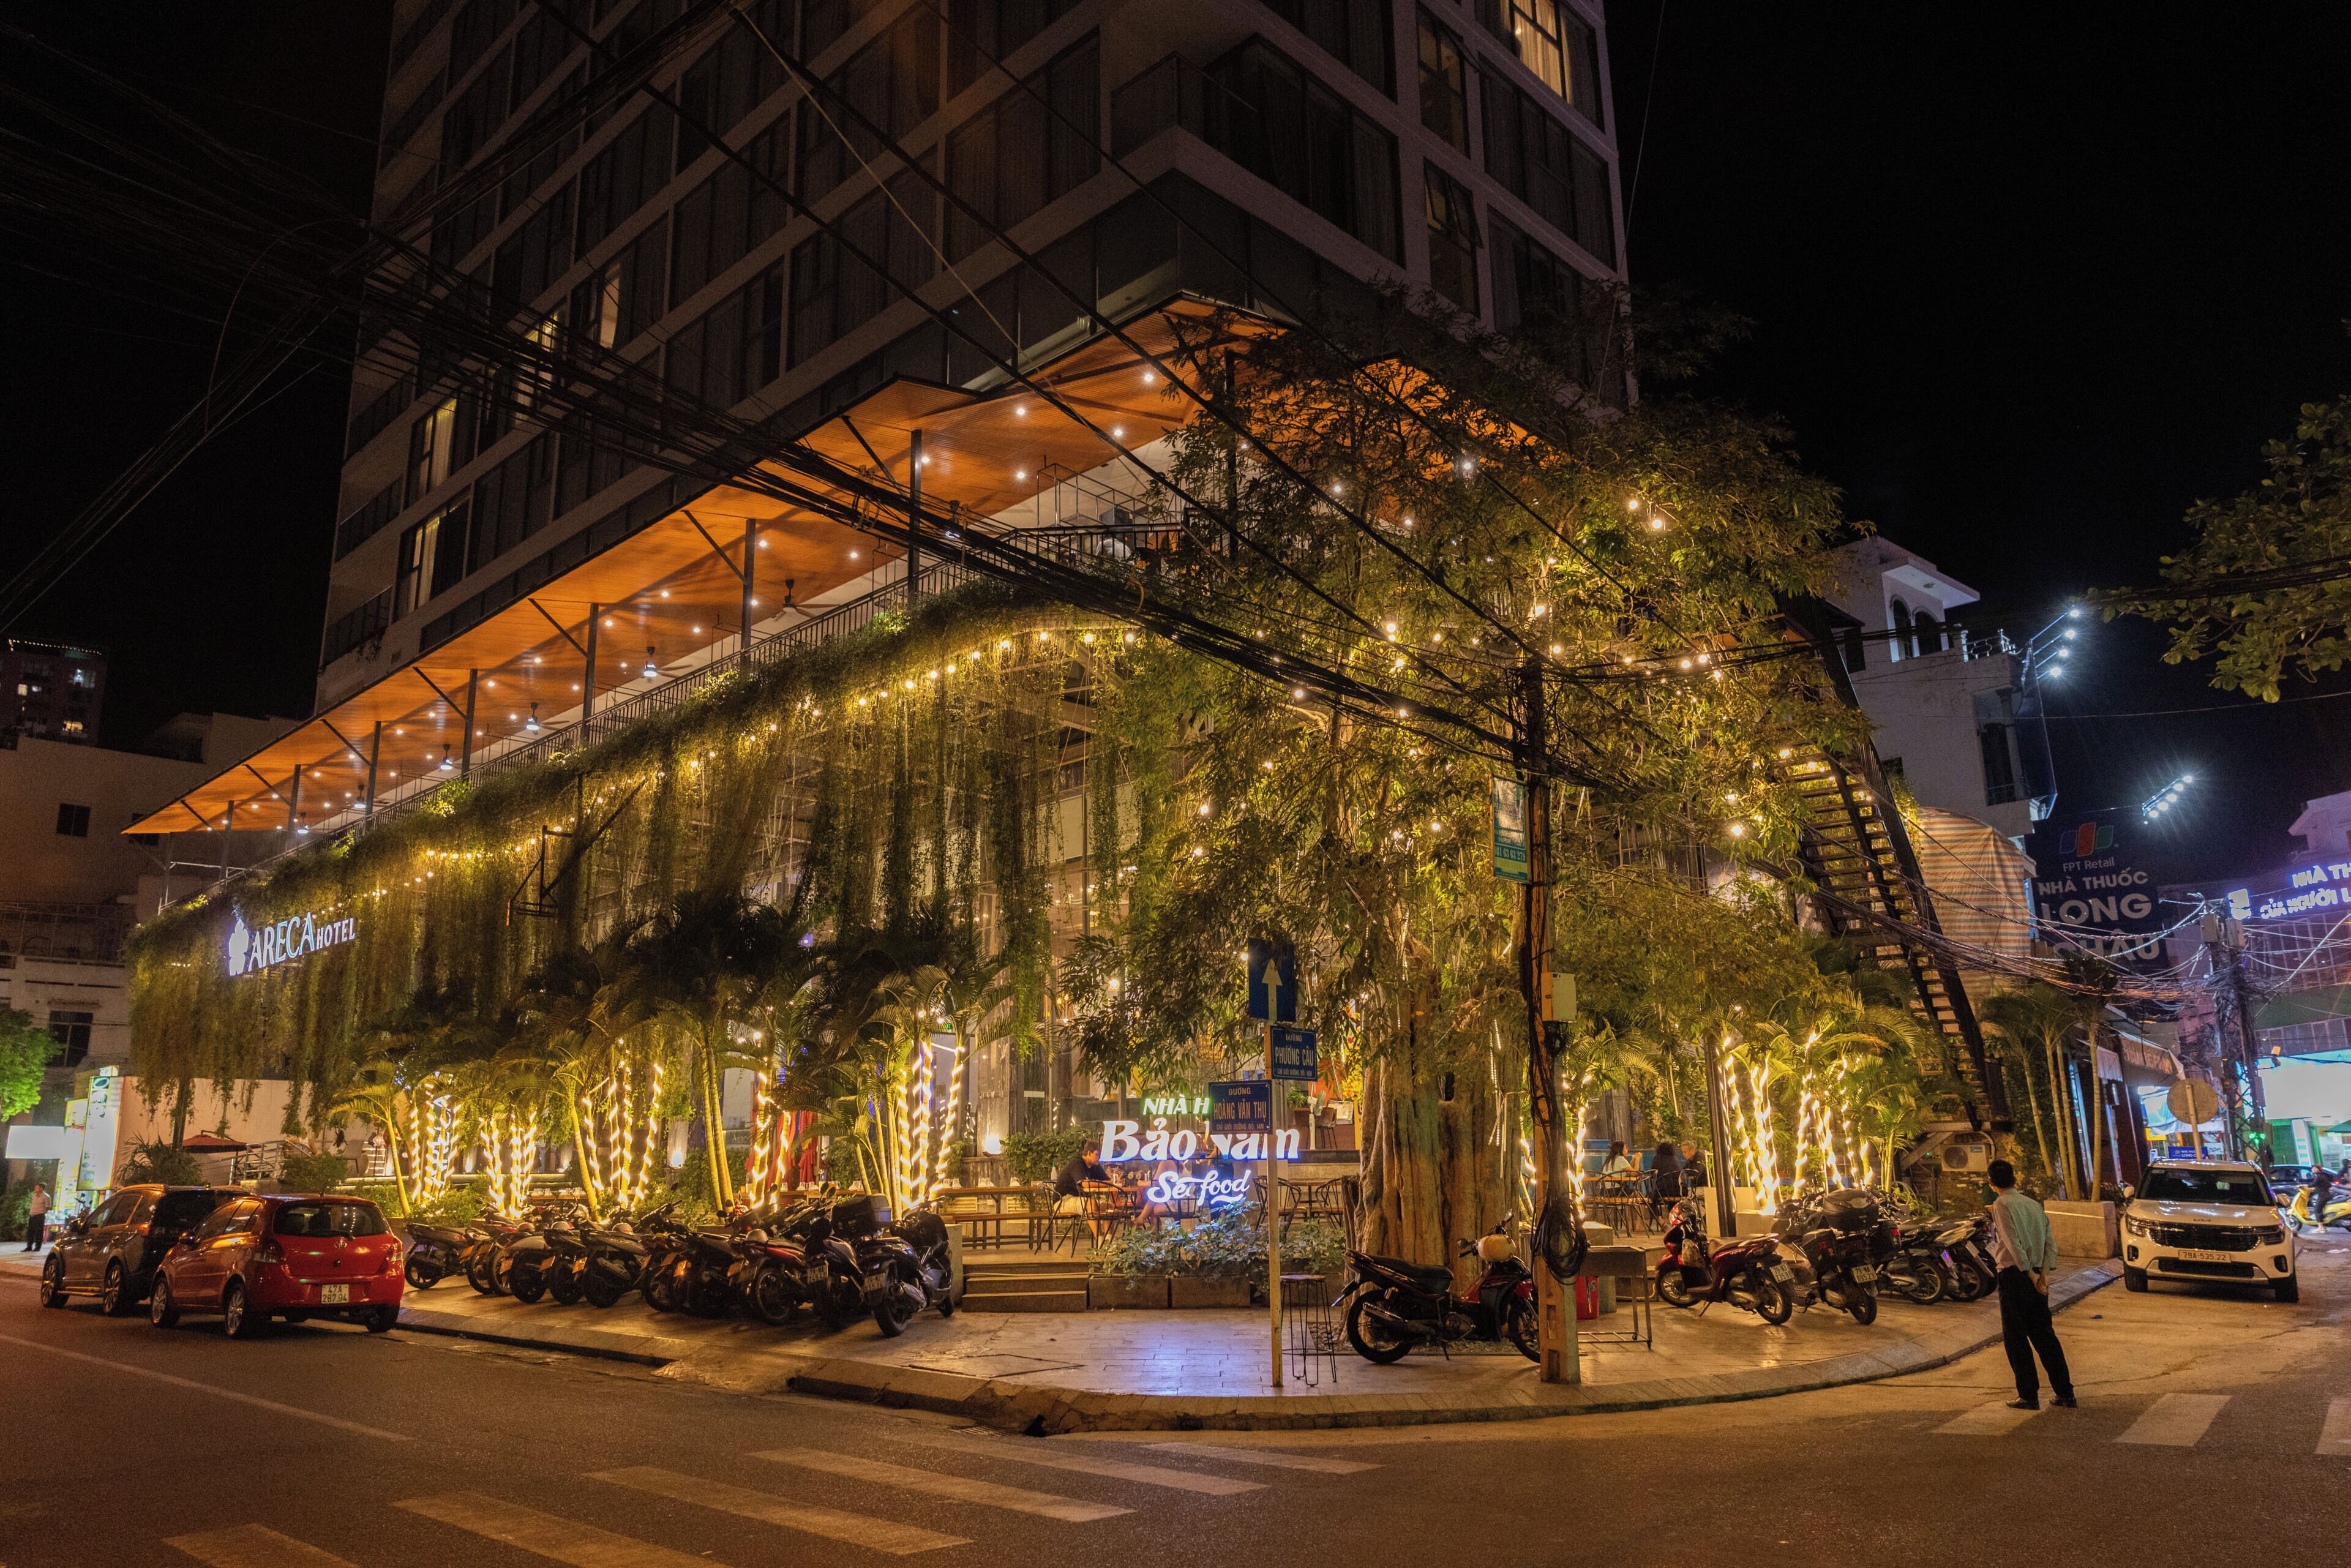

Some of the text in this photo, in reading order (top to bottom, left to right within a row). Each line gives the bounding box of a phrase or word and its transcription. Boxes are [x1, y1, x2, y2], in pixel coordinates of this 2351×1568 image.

[2063, 857, 2115, 872] FPT Retail
[2038, 867, 2148, 896] NHÀ THUỐC
[2041, 893, 2152, 927] LONG
[247, 912, 356, 972] ARECA HOTEL
[1302, 1045, 1314, 1067] CÂU
[1142, 1094, 1188, 1115] NHÀ
[1213, 1098, 1267, 1122] HOÀNG VĂN THỤ
[1099, 1118, 1197, 1162] Bảo
[2183, 1251, 2226, 1261] 79A-535.22
[328, 1285, 342, 1294] 47A
